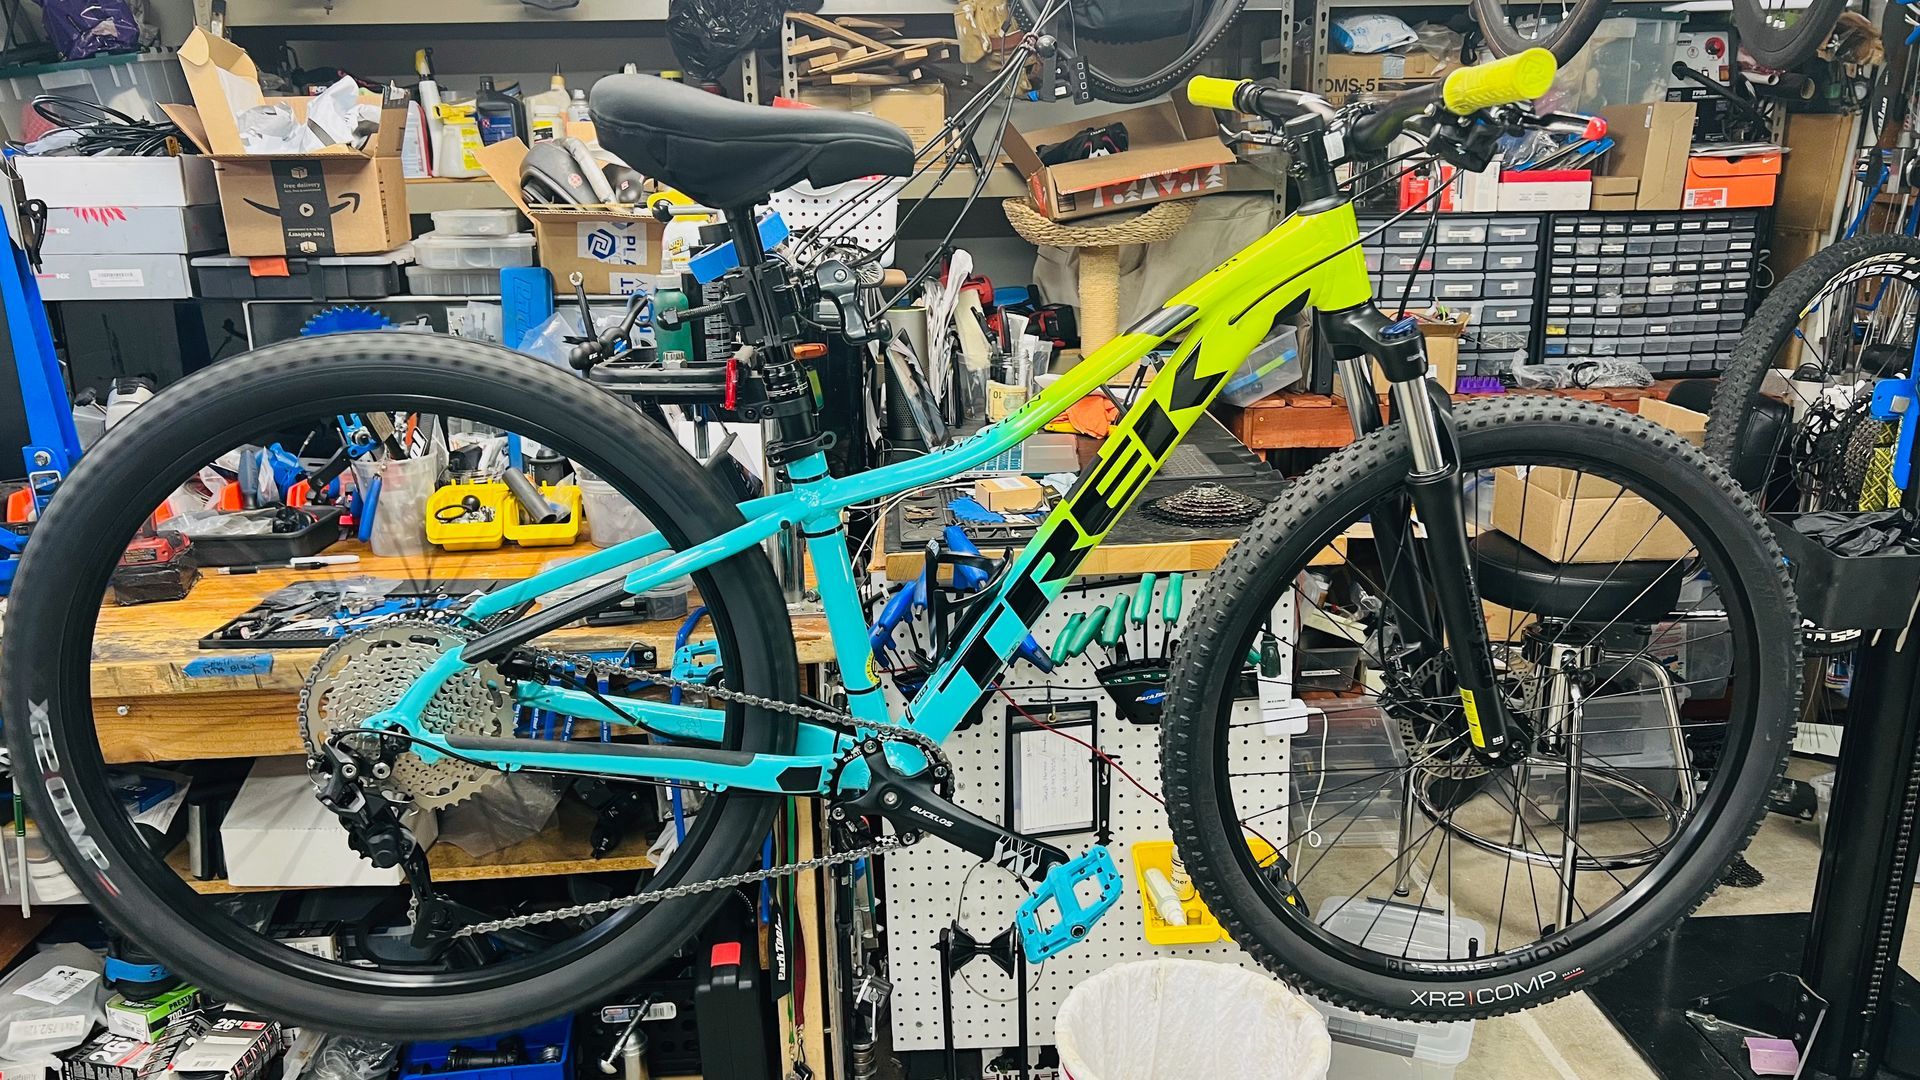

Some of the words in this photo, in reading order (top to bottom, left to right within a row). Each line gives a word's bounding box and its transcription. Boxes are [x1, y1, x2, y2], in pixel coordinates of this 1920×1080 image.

[941, 394, 1041, 455] MARLIN
[990, 336, 1230, 630] TREK
[910, 805, 955, 828] BUCKLOS
